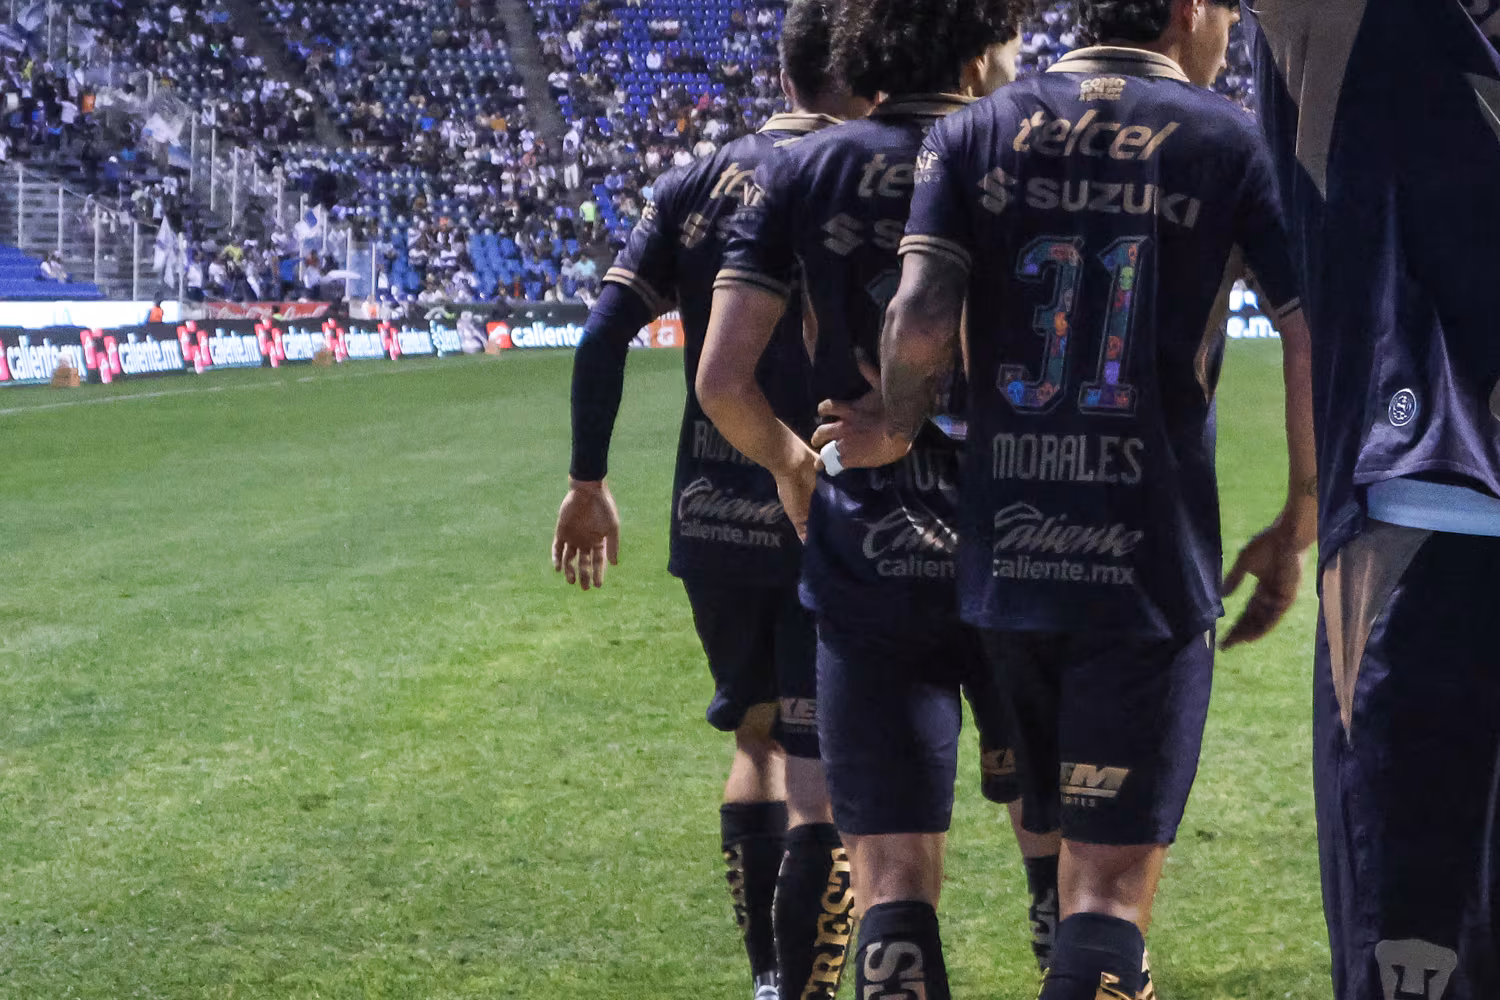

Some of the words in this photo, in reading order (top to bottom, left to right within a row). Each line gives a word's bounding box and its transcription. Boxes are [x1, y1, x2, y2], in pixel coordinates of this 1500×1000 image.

[1013, 109, 1181, 161] telcel
[1027, 178, 1199, 229] SUZUKI
[997, 235, 1147, 416] 31
[6, 334, 88, 381] calientemx
[118, 332, 184, 374] caliente.mx
[993, 432, 1145, 485] MORALES
[876, 553, 956, 577] calien
[993, 555, 1135, 585] aliente.mx
